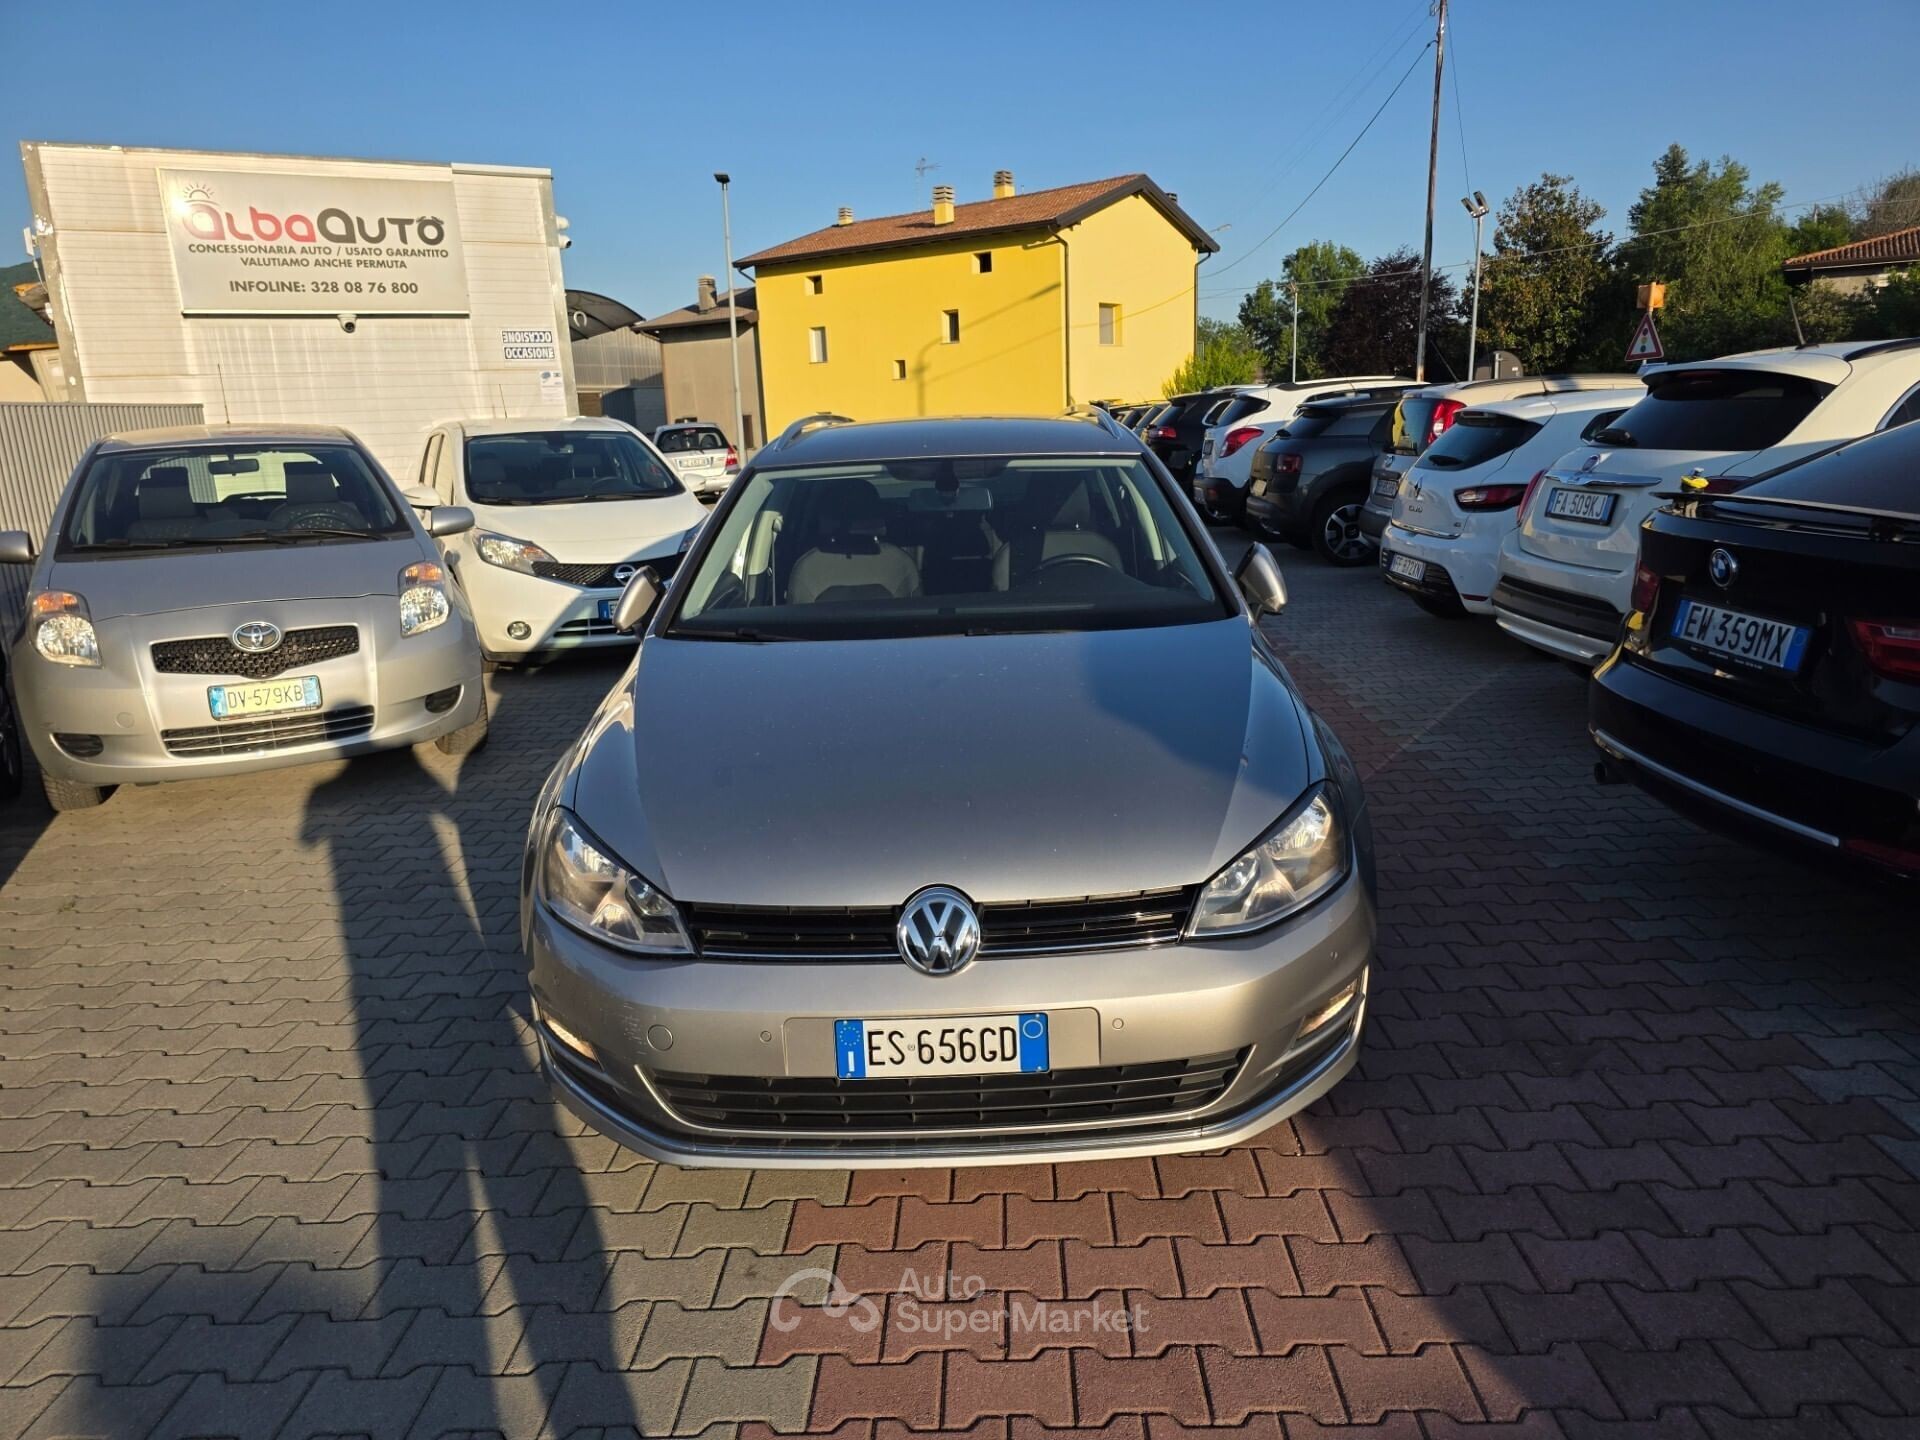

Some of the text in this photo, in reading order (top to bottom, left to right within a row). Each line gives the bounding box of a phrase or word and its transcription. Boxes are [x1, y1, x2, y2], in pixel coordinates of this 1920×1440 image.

[188, 243, 296, 255] CONCESSIONARIA
[300, 245, 332, 256] AUTO
[345, 247, 382, 257] USATO
[386, 247, 449, 258] GARANTITO
[240, 257, 408, 269] VALUTIAMO ANCHE PERMUTA
[229, 280, 418, 294] INFOLINE: 328 08 76 800
[505, 347, 555, 359] OCCASIONE
[1684, 605, 1716, 641] EW
[1714, 613, 1791, 663] 359MX
[867, 1030, 905, 1066] ES
[917, 1026, 1018, 1065] 656GD
